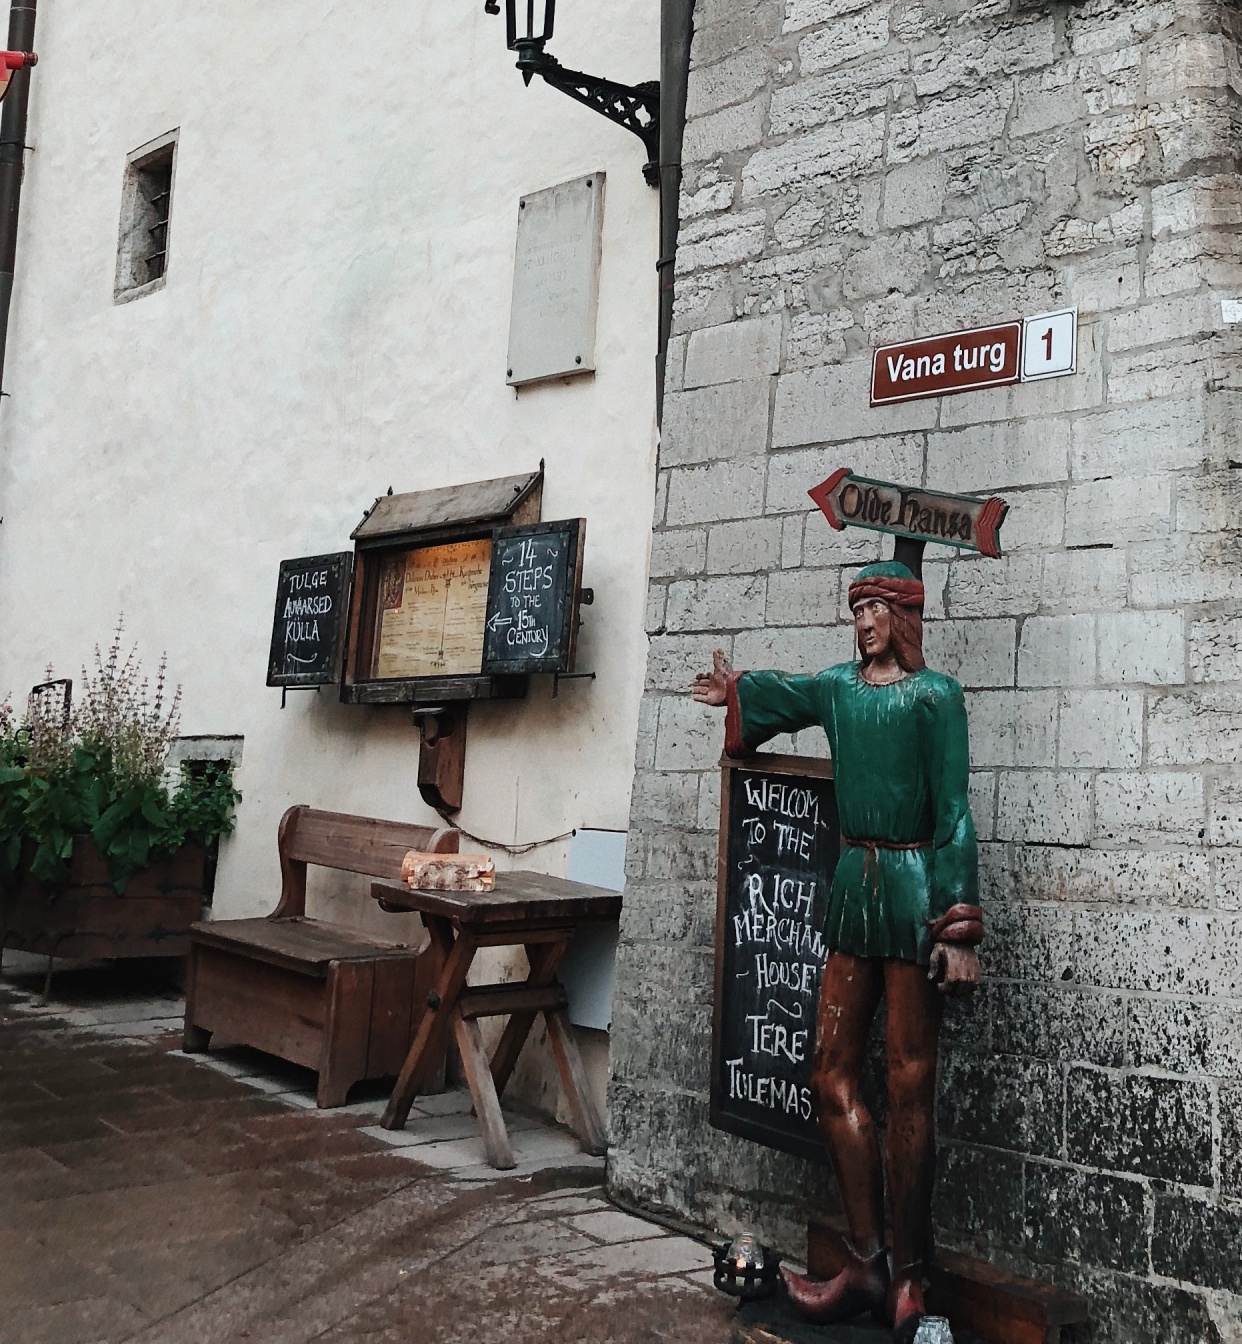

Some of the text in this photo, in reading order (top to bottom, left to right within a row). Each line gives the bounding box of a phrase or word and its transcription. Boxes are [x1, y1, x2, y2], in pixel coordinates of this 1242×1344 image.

[887, 342, 1006, 383] Vana turg
[1041, 327, 1053, 361] 1
[839, 483, 893, 526] Olde
[518, 538, 537, 568] 14
[289, 570, 328, 593] TULGE
[503, 564, 553, 593] STEPS
[510, 594, 542, 608] TO THE
[517, 609, 536, 631] 15TH
[506, 624, 549, 657] CENTURY
[744, 778, 824, 826] WELCOM
[742, 817, 815, 861] TO THE
[748, 872, 816, 918] RICH
[755, 952, 817, 996] HOUSE
[745, 1014, 808, 1064] TERE
[726, 1057, 813, 1121] TULEMAS
